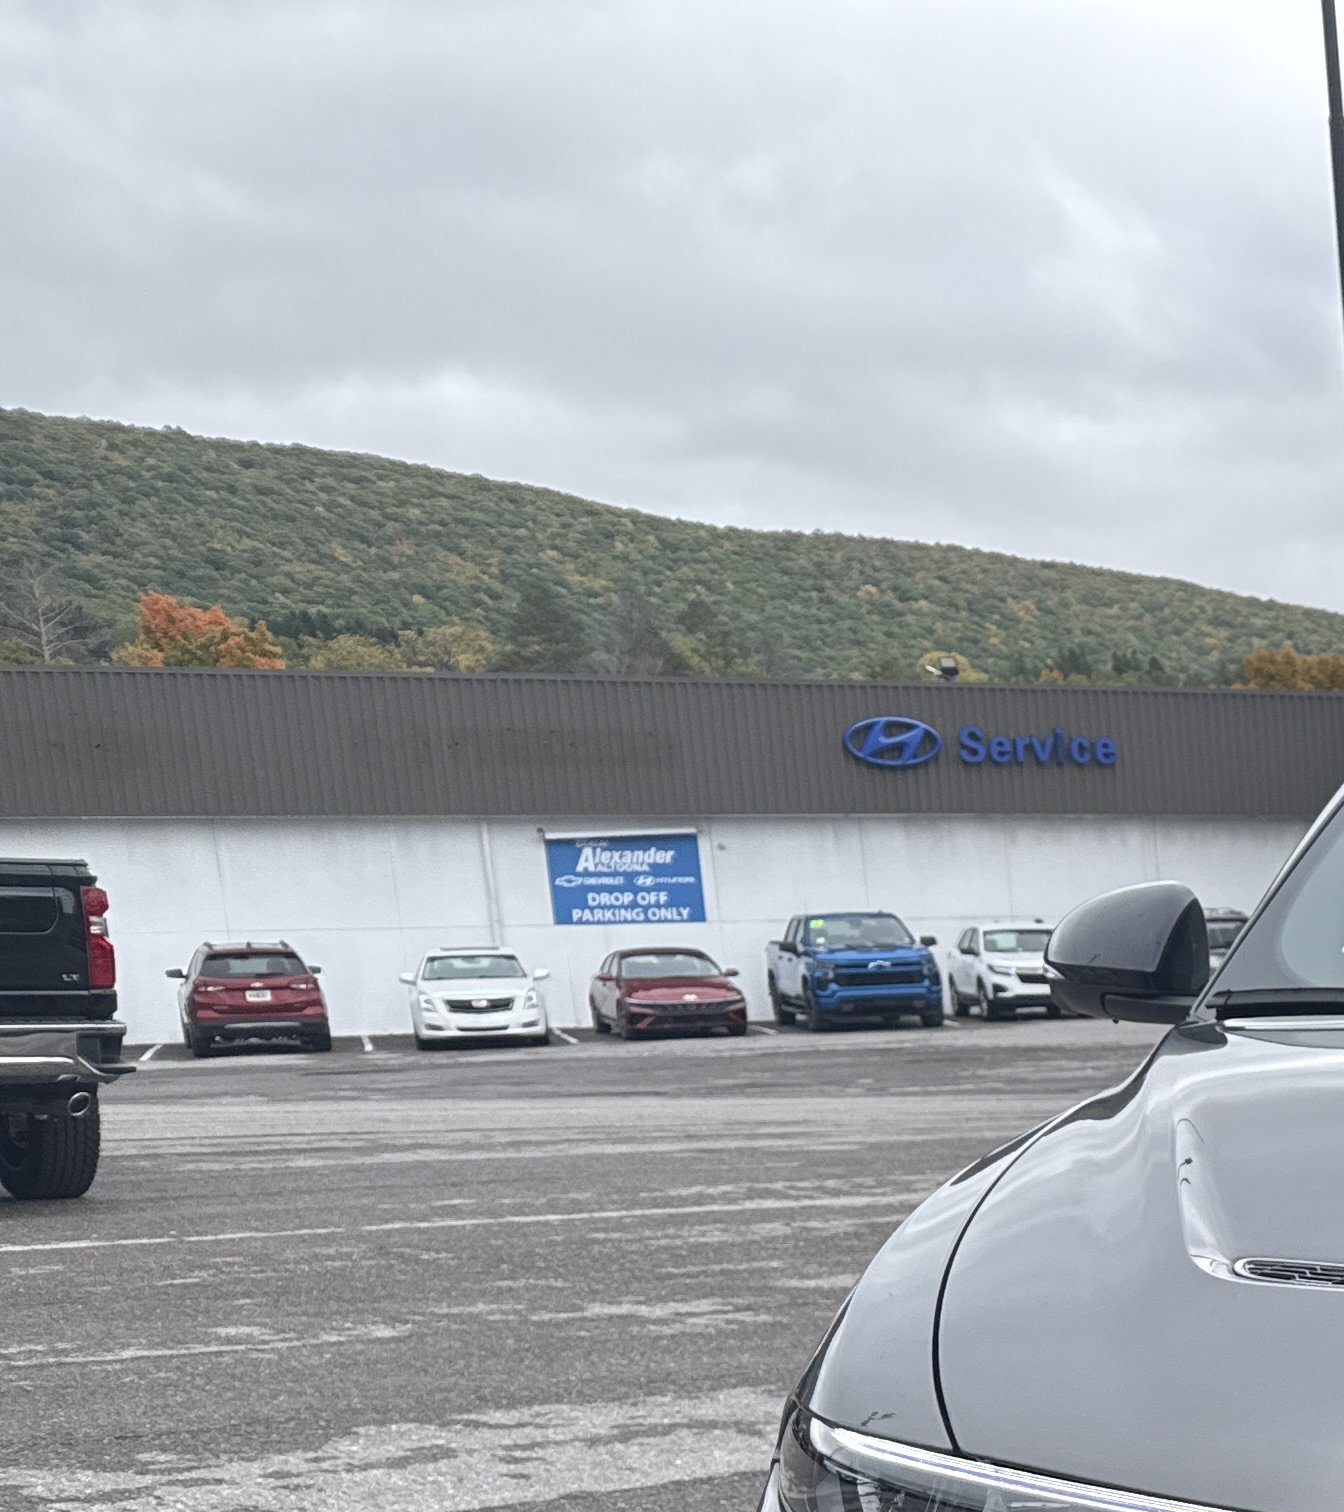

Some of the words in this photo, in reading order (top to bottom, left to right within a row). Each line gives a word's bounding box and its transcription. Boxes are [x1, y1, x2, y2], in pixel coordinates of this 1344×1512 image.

[958, 724, 1117, 766] Service
[575, 847, 675, 872] Alexander
[587, 892, 633, 906] DROP
[637, 891, 668, 905] OFF
[572, 908, 644, 922] PARKING
[648, 907, 690, 921] ONLY
